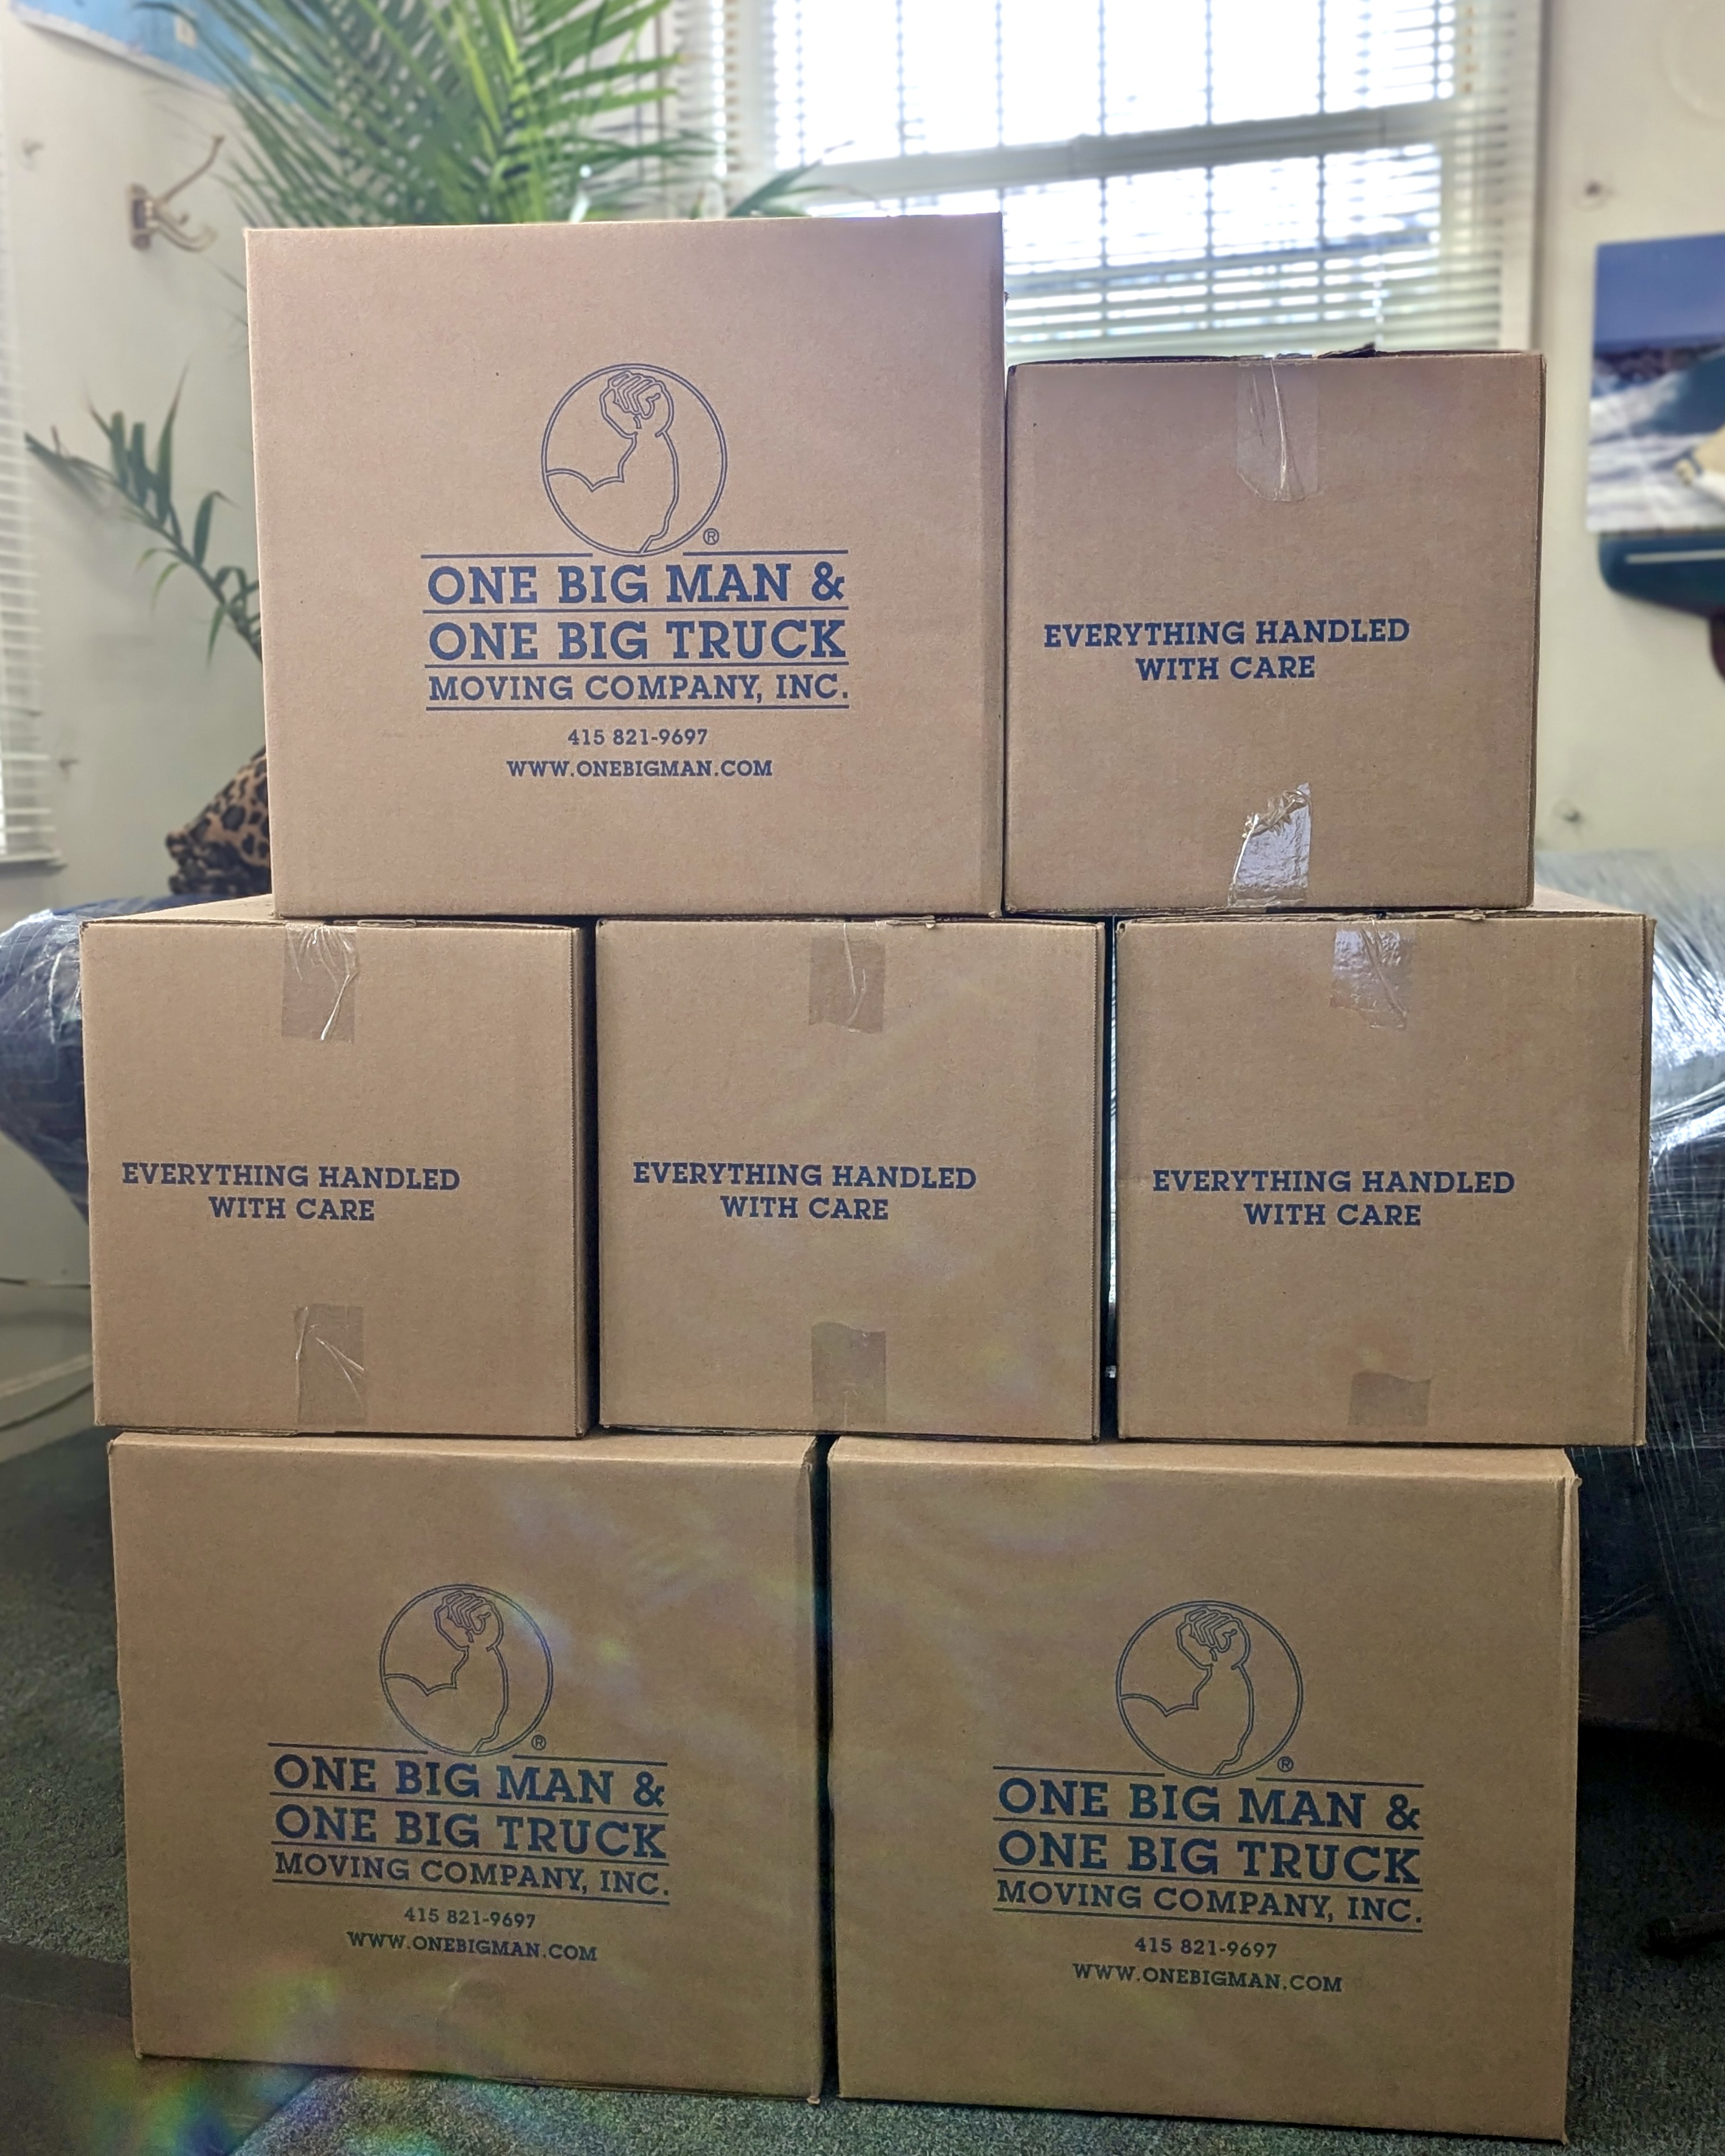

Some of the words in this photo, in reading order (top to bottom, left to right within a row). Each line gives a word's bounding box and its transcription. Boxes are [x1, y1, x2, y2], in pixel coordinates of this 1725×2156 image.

[428, 566, 537, 605] ONE
[558, 565, 648, 603] BIG
[666, 564, 791, 602] MAN
[811, 561, 844, 601] &
[429, 622, 538, 660] ONE
[558, 621, 647, 659] BIG
[666, 620, 845, 659] TRUCK
[1044, 621, 1244, 647] EVERYTHING
[1256, 618, 1410, 644] HANDLED
[1135, 657, 1219, 681] WITH
[1231, 655, 1314, 679] CARE
[429, 676, 573, 701] MOVING
[586, 675, 762, 704] COMPANY,
[776, 674, 848, 698] INC.
[568, 729, 604, 745] 415
[613, 728, 707, 745] 821-9697
[506, 760, 772, 777] WWW.ONEBIGMAN.COM
[122, 1162, 308, 1187] EVERYTHING
[319, 1166, 460, 1190] HANDLED
[633, 1162, 821, 1185] EVERYTHING
[832, 1166, 976, 1189] HANDLED
[1153, 1170, 1350, 1192] EVERYTHING
[1363, 1171, 1515, 1193] HANDLED
[209, 1196, 286, 1219] WITH
[297, 1198, 374, 1221] CARE
[720, 1196, 798, 1218] WITH
[809, 1197, 888, 1220] CARE
[1244, 1204, 1325, 1225] WITH
[1337, 1204, 1420, 1226] CARE
[274, 1754, 375, 1792] ONE
[396, 1761, 479, 1798] BIG
[497, 1766, 614, 1804] MAN
[633, 1772, 665, 1807] &
[999, 1778, 1107, 1816] ONE
[1130, 1784, 1219, 1822] BIG
[1238, 1788, 1366, 1828] MAN
[1386, 1794, 1420, 1831] &
[276, 1805, 376, 1842] ONE
[396, 1811, 479, 1848] BIG
[497, 1816, 666, 1858] TRUCK
[999, 1829, 1106, 1869] ONE
[1128, 1836, 1217, 1875] BIG
[1237, 1841, 1420, 1884] TRUCK
[276, 1852, 409, 1880] MOVING
[421, 1860, 587, 1894] COMPANY,
[601, 1870, 669, 1896] INC.
[997, 1879, 1141, 1908] MOVING
[1154, 1888, 1333, 1922] COMPANY,
[1348, 1897, 1421, 1923] INC.
[405, 1908, 439, 1922] 415
[447, 1910, 535, 1928] 821-9697
[346, 1931, 597, 1961] WWW.ONEBIGMAN.COM
[1135, 1937, 1172, 1952] 415
[1181, 1939, 1276, 1958] 821-9697
[1072, 1963, 1342, 1992] WWW.ONEBIGMAN.COM
